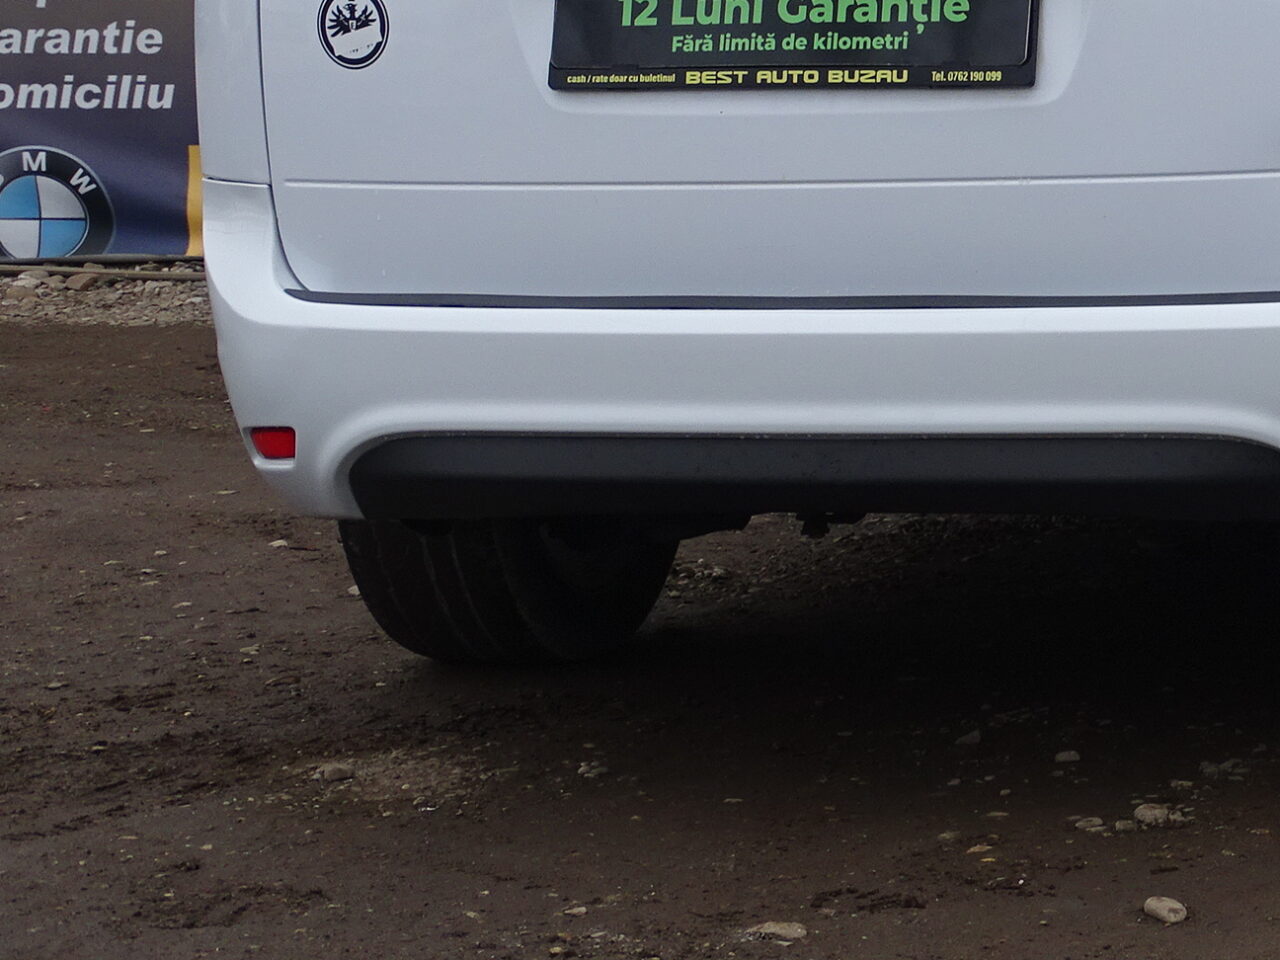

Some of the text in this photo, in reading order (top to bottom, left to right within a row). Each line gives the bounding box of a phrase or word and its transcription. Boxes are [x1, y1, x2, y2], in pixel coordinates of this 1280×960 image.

[671, 31, 909, 52] Fără limită de kilometri
[566, 74, 586, 83] cash
[592, 74, 609, 83] rate
[609, 74, 628, 83] doar
[628, 74, 638, 83] cu
[639, 73, 676, 83] buletinul
[685, 69, 909, 85] BEST AUTO BUZAU
[931, 71, 1002, 82] Tel. 0762 190 099
[0, 151, 97, 196] MW
